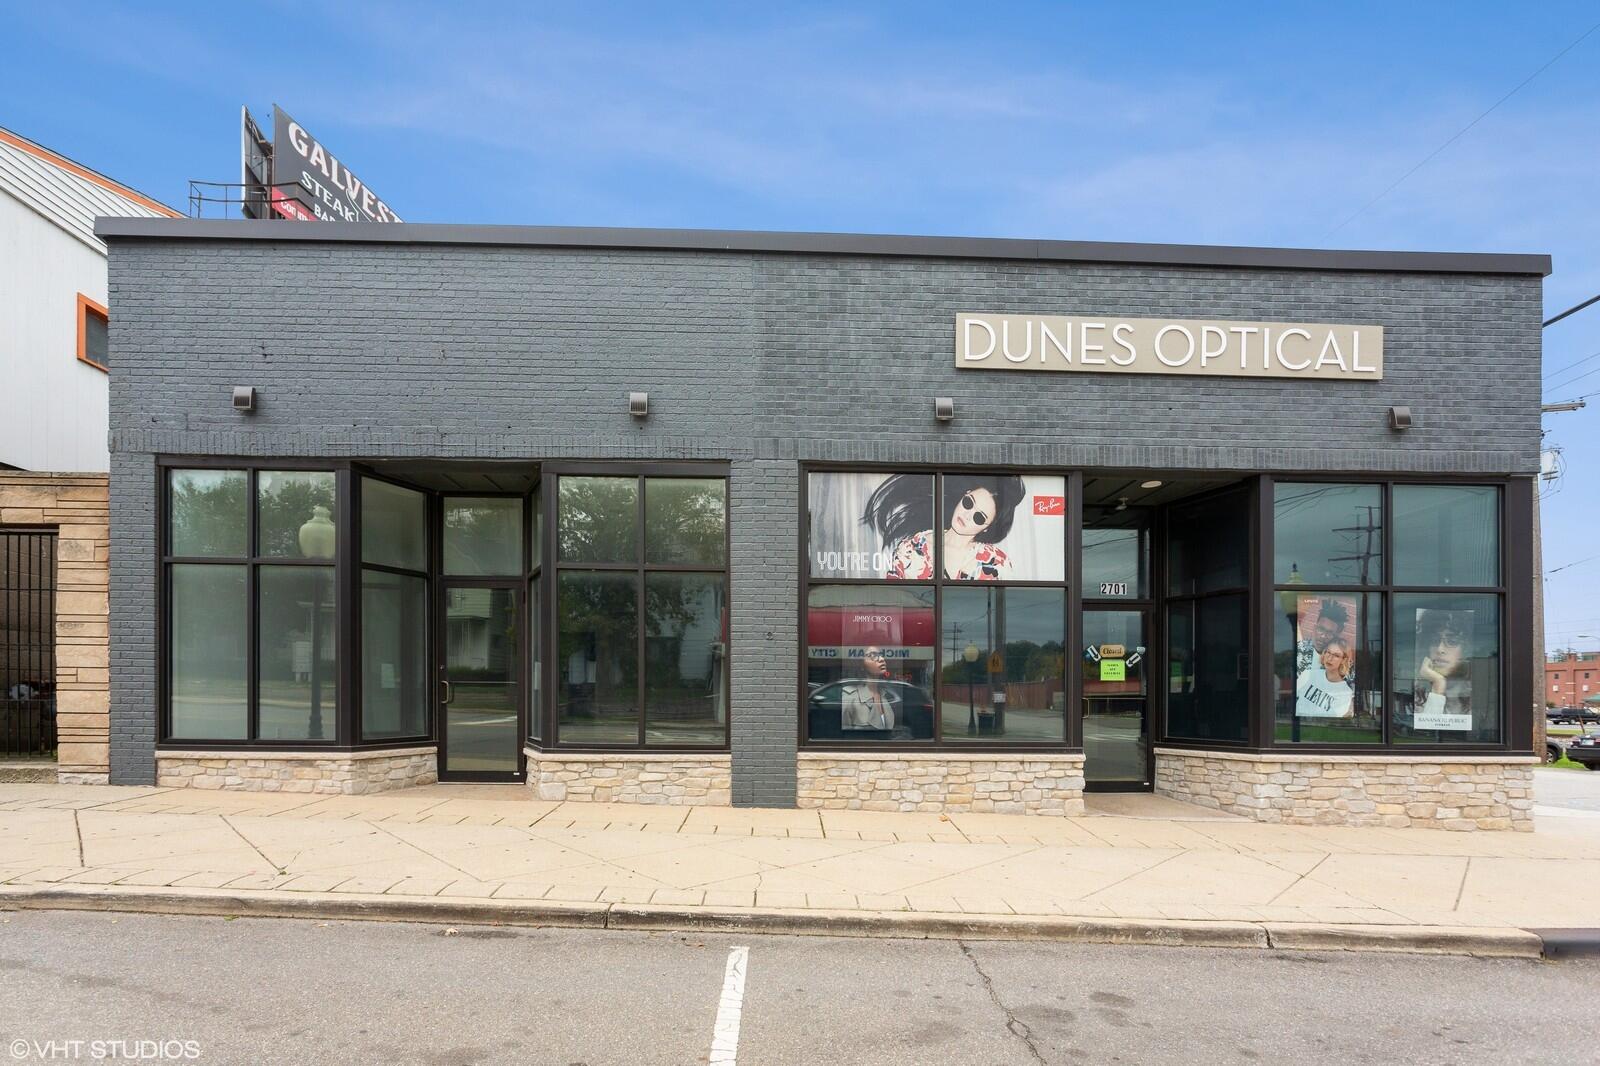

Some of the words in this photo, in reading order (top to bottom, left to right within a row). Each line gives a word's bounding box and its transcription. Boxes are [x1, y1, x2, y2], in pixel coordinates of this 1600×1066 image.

[963, 318, 1137, 367] DUNES
[1154, 323, 1377, 373] OPTICAL
[817, 551, 869, 571] YOU'RE
[872, 552, 893, 571] ON
[1101, 583, 1127, 595] 2701
[1303, 684, 1335, 712] LEVI'S
